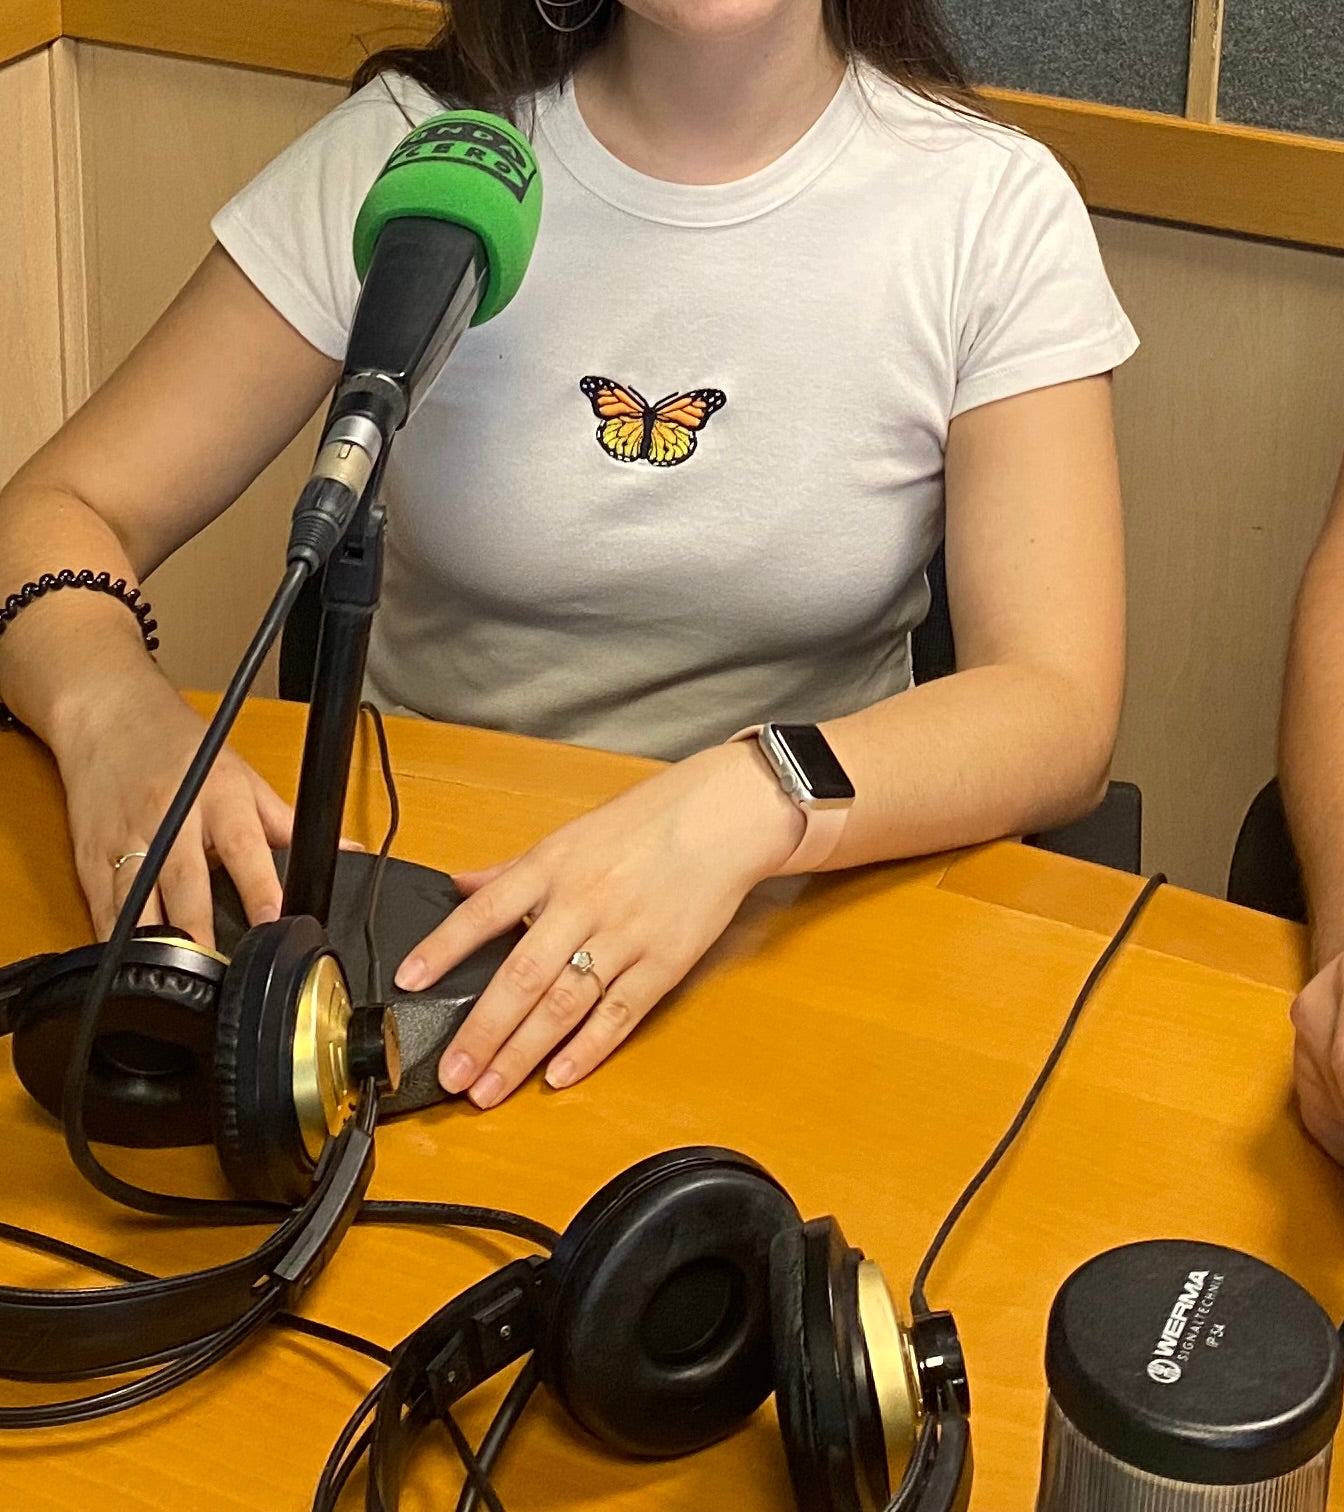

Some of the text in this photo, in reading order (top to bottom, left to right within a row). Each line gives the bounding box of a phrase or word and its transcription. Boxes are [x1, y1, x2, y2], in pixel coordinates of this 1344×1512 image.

[406, 143, 513, 174] CERO
[407, 125, 519, 159] ONDA
[1151, 1269, 1211, 1357] WERMA
